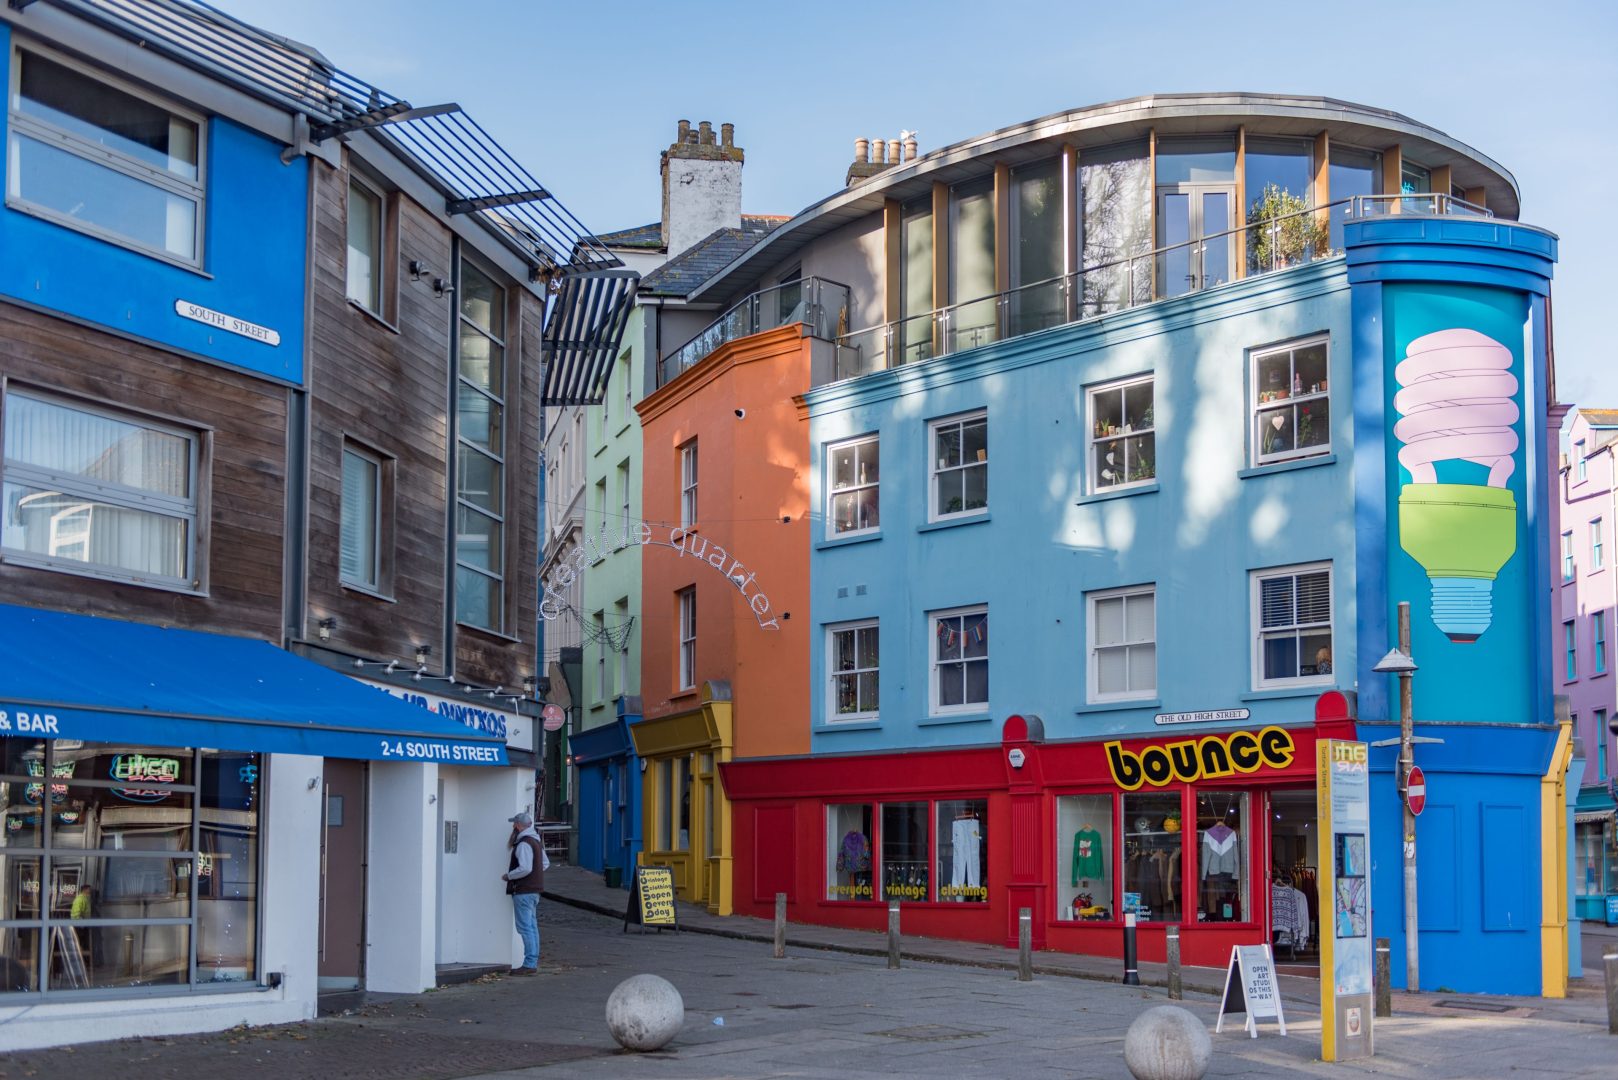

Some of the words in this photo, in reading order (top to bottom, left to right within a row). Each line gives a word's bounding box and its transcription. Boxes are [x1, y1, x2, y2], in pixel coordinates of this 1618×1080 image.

[189, 305, 226, 326] SOUTH
[233, 320, 270, 340] STREET
[539, 522, 651, 621] creative
[670, 527, 780, 631] quarter
[16, 712, 60, 734] BAR
[1160, 715, 1175, 723] THE
[1177, 713, 1192, 722] OLD
[1194, 712, 1213, 721] HIGH
[1216, 710, 1242, 719] STREET
[381, 741, 404, 757] 2-4
[406, 742, 450, 760] SOUTH
[453, 745, 499, 762] STREET
[1104, 726, 1295, 791] bounce
[651, 892, 671, 900] open
[886, 883, 926, 899] vintage
[940, 884, 988, 899] clothing
[654, 909, 670, 917] day
